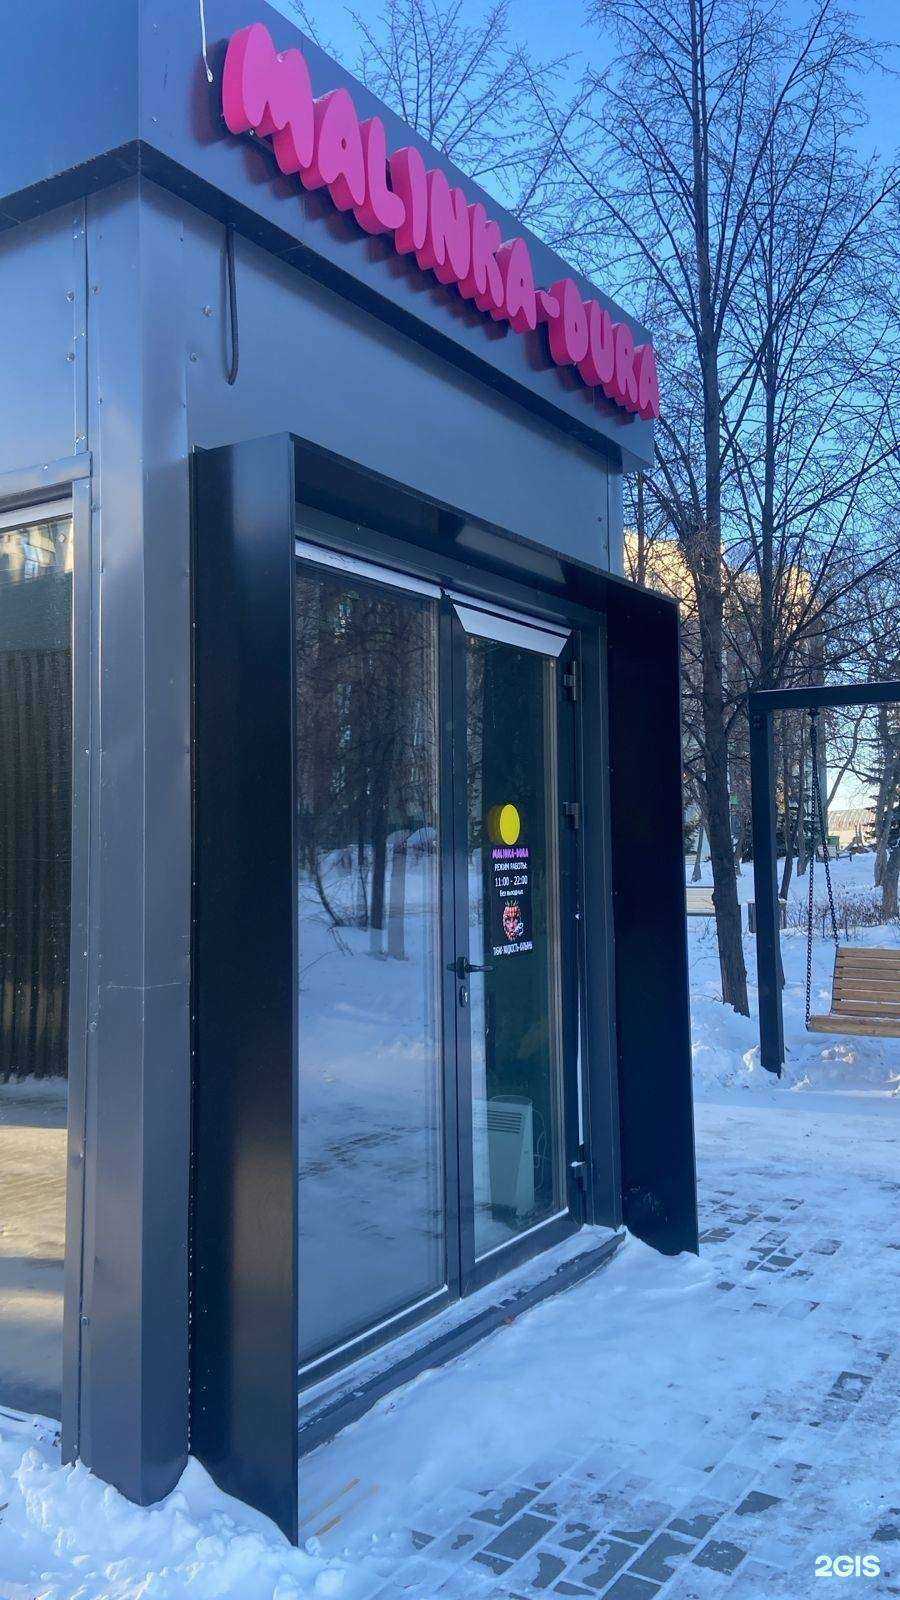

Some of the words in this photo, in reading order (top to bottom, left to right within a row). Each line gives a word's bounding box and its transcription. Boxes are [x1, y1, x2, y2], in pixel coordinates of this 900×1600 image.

[222, 22, 660, 420] MALINKA-DURA
[494, 863, 510, 872] РЕЖИМ
[495, 876, 510, 887] 11:00
[513, 875, 528, 886] 22:00
